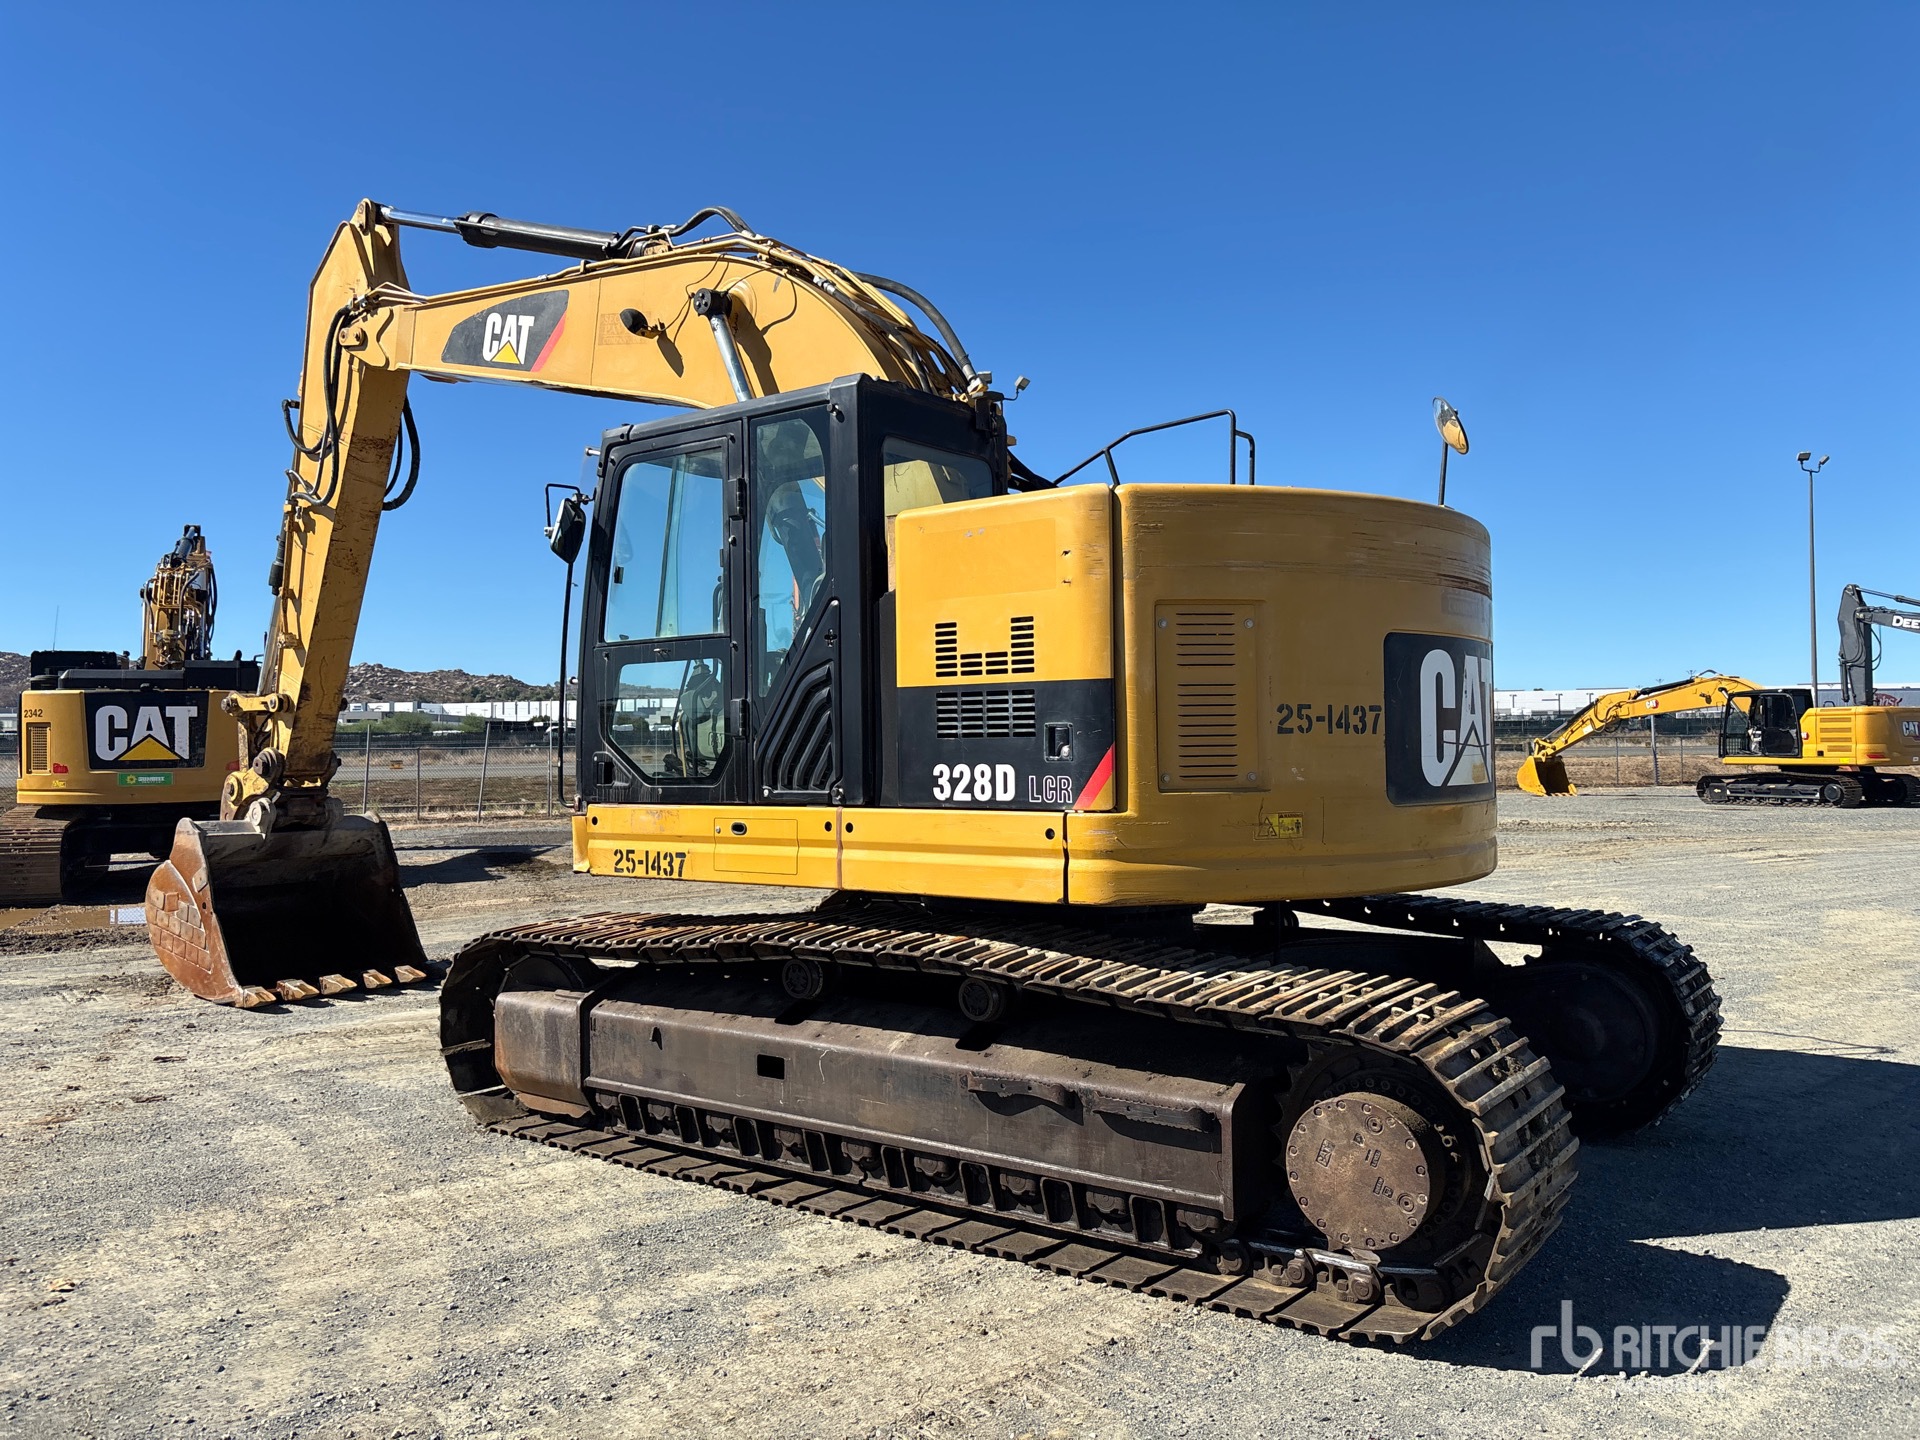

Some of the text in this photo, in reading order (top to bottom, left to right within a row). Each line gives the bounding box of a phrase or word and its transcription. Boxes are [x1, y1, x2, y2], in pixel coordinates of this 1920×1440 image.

[483, 312, 535, 364] CAT
[1892, 615, 1920, 629] DEE
[24, 708, 43, 718] 2342
[1276, 703, 1383, 735] 25-1437
[1902, 721, 1919, 736] CAT
[95, 705, 198, 761] CAT
[932, 763, 1073, 803] 328D LCR
[613, 848, 687, 878] 25-1437
